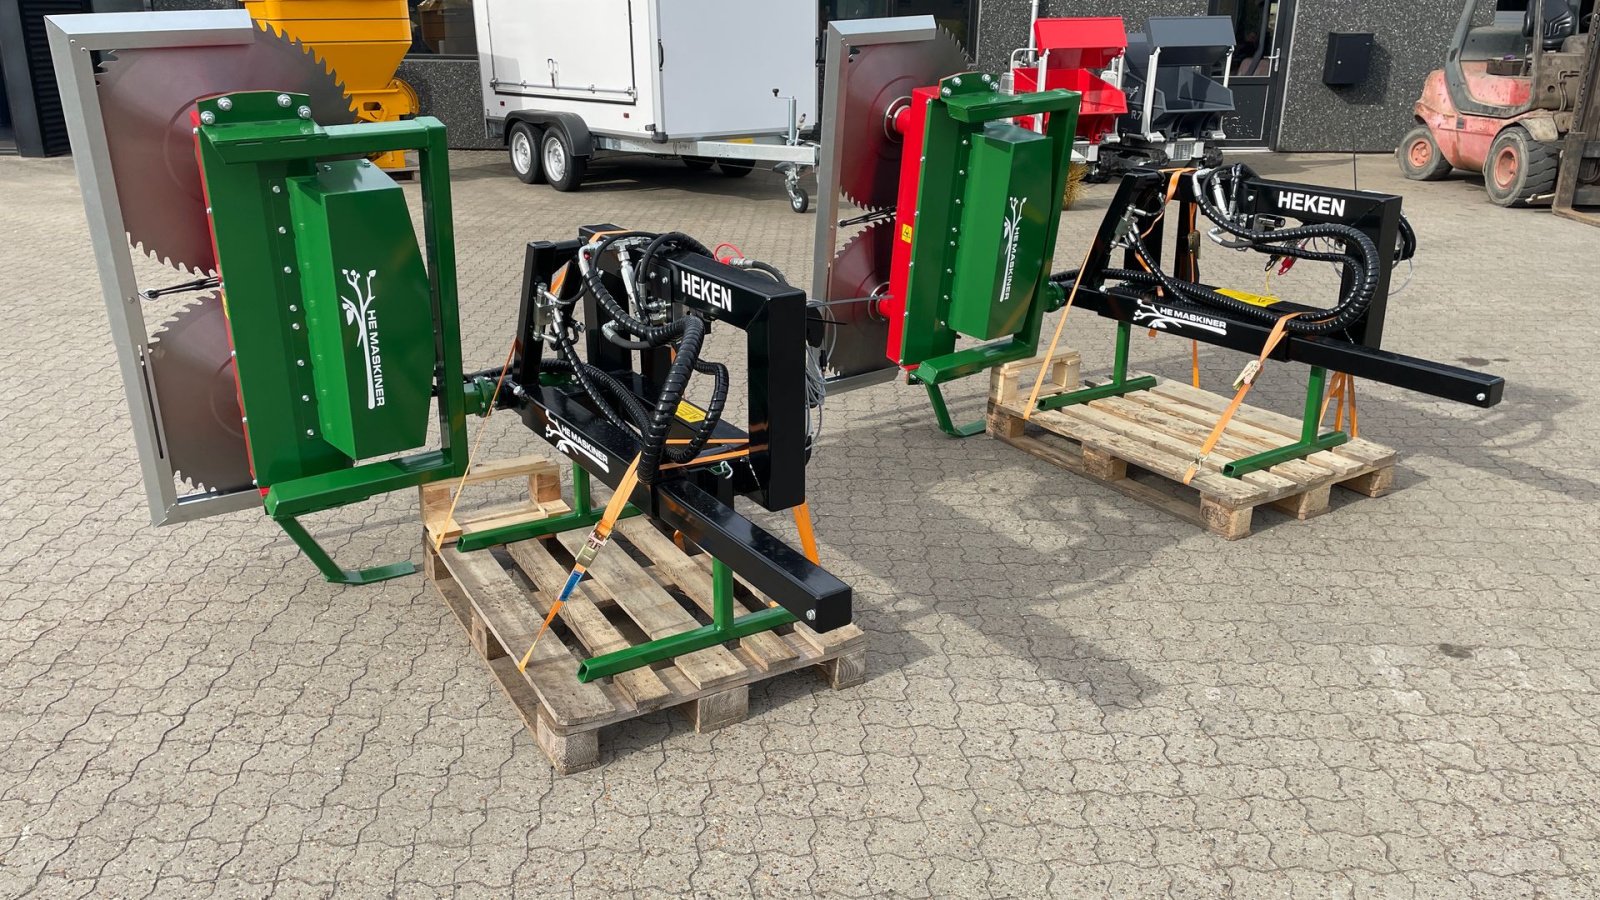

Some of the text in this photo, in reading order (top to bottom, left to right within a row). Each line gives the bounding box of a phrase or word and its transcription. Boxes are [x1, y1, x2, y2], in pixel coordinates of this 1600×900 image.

[1277, 190, 1346, 217] HEKEN
[1004, 226, 1021, 300] HE MASKINER
[681, 270, 732, 313] HEKEN
[1159, 306, 1227, 329] HE MASKINER
[367, 309, 386, 407] HE MASKINER
[561, 424, 609, 465] HE MASKINER
